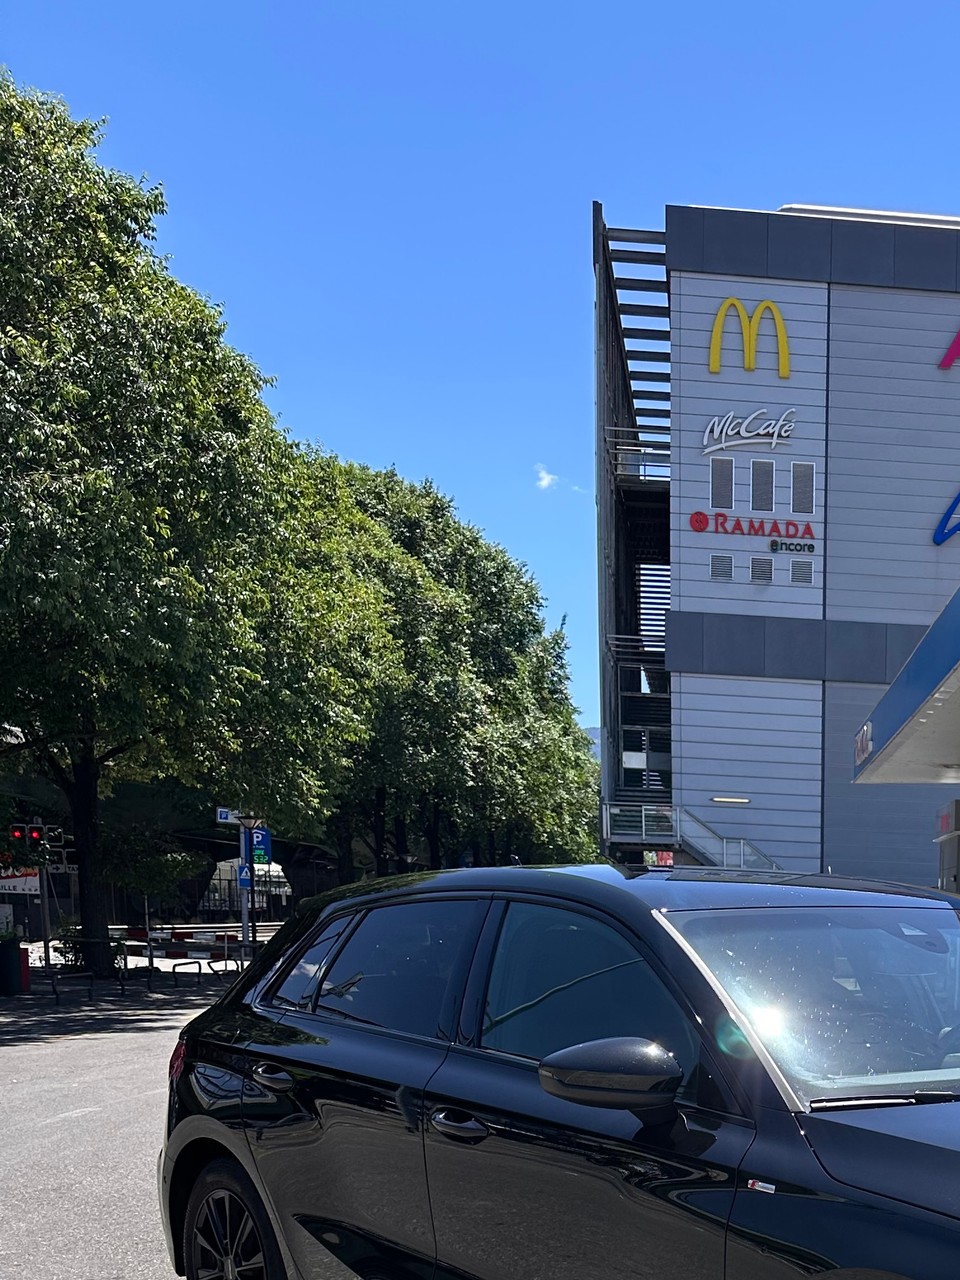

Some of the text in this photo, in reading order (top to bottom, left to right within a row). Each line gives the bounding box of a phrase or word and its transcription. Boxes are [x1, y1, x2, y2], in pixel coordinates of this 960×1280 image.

[703, 408, 796, 450] McCafé
[714, 512, 815, 539] RAMADA
[769, 539, 815, 553] encore
